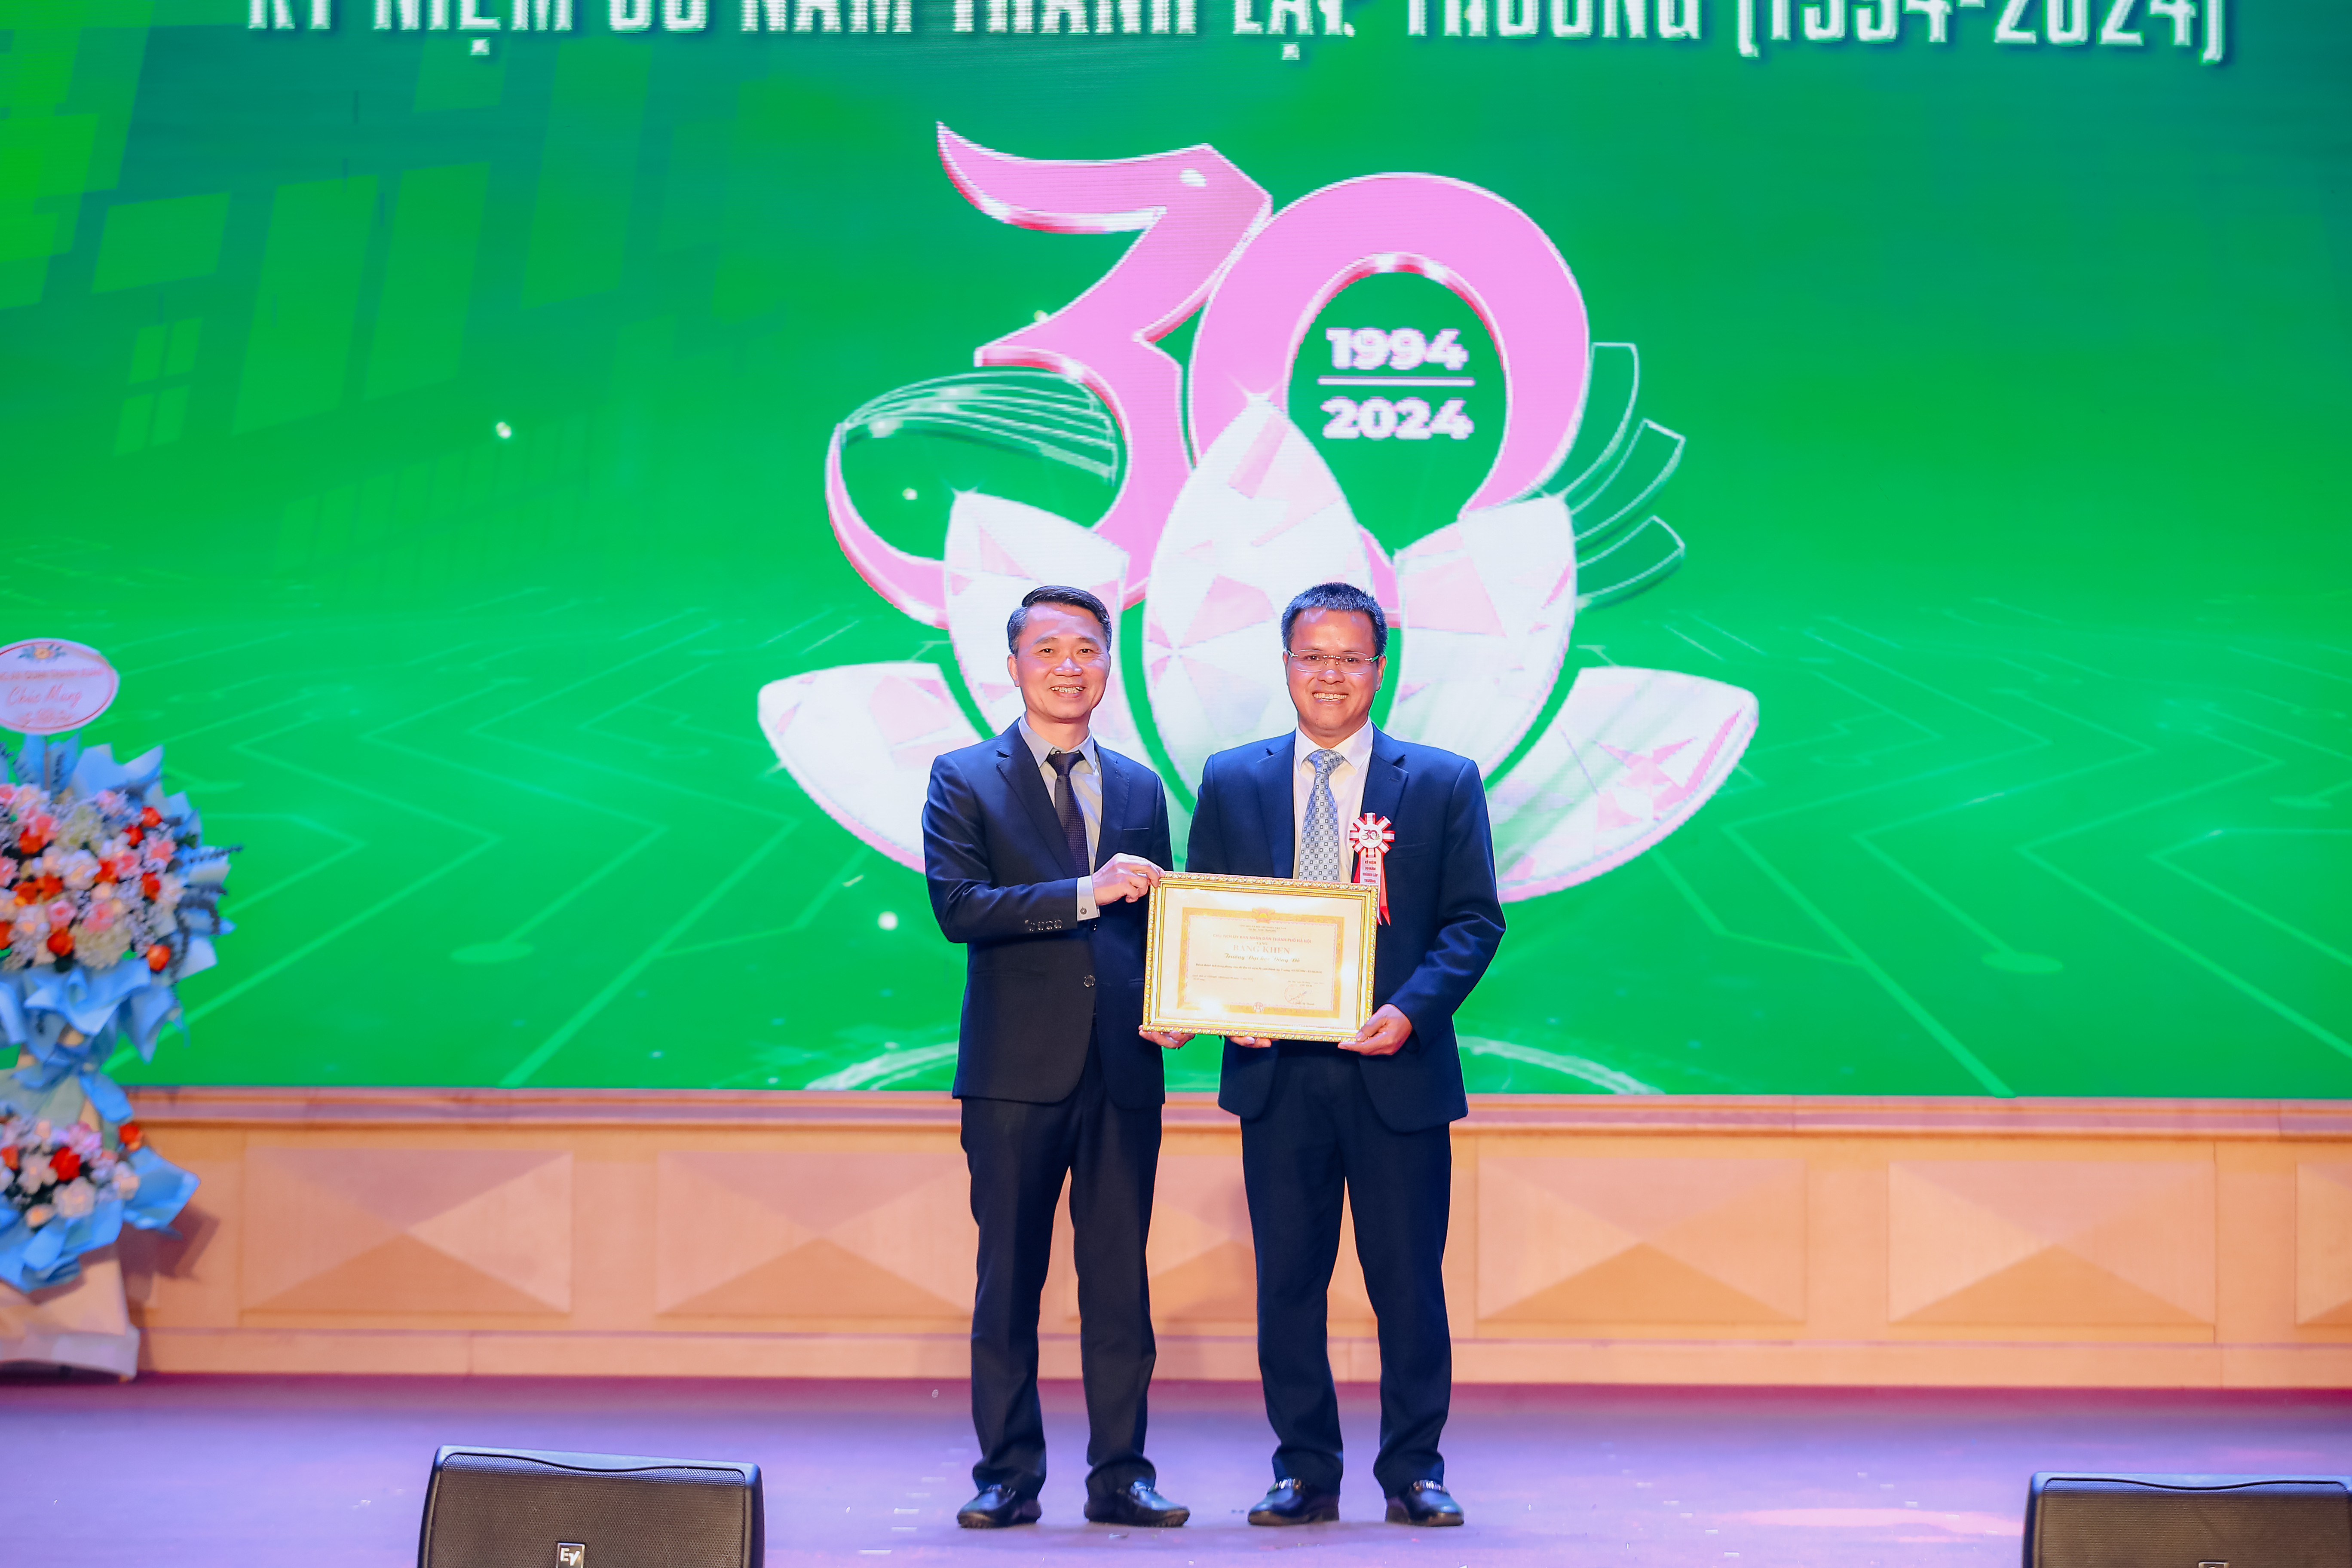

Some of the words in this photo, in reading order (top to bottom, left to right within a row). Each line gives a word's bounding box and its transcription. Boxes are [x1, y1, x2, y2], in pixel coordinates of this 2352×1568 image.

[1326, 327, 1469, 371] 1994
[1320, 396, 1475, 440] 2024
[560, 1547, 580, 1567] EV
